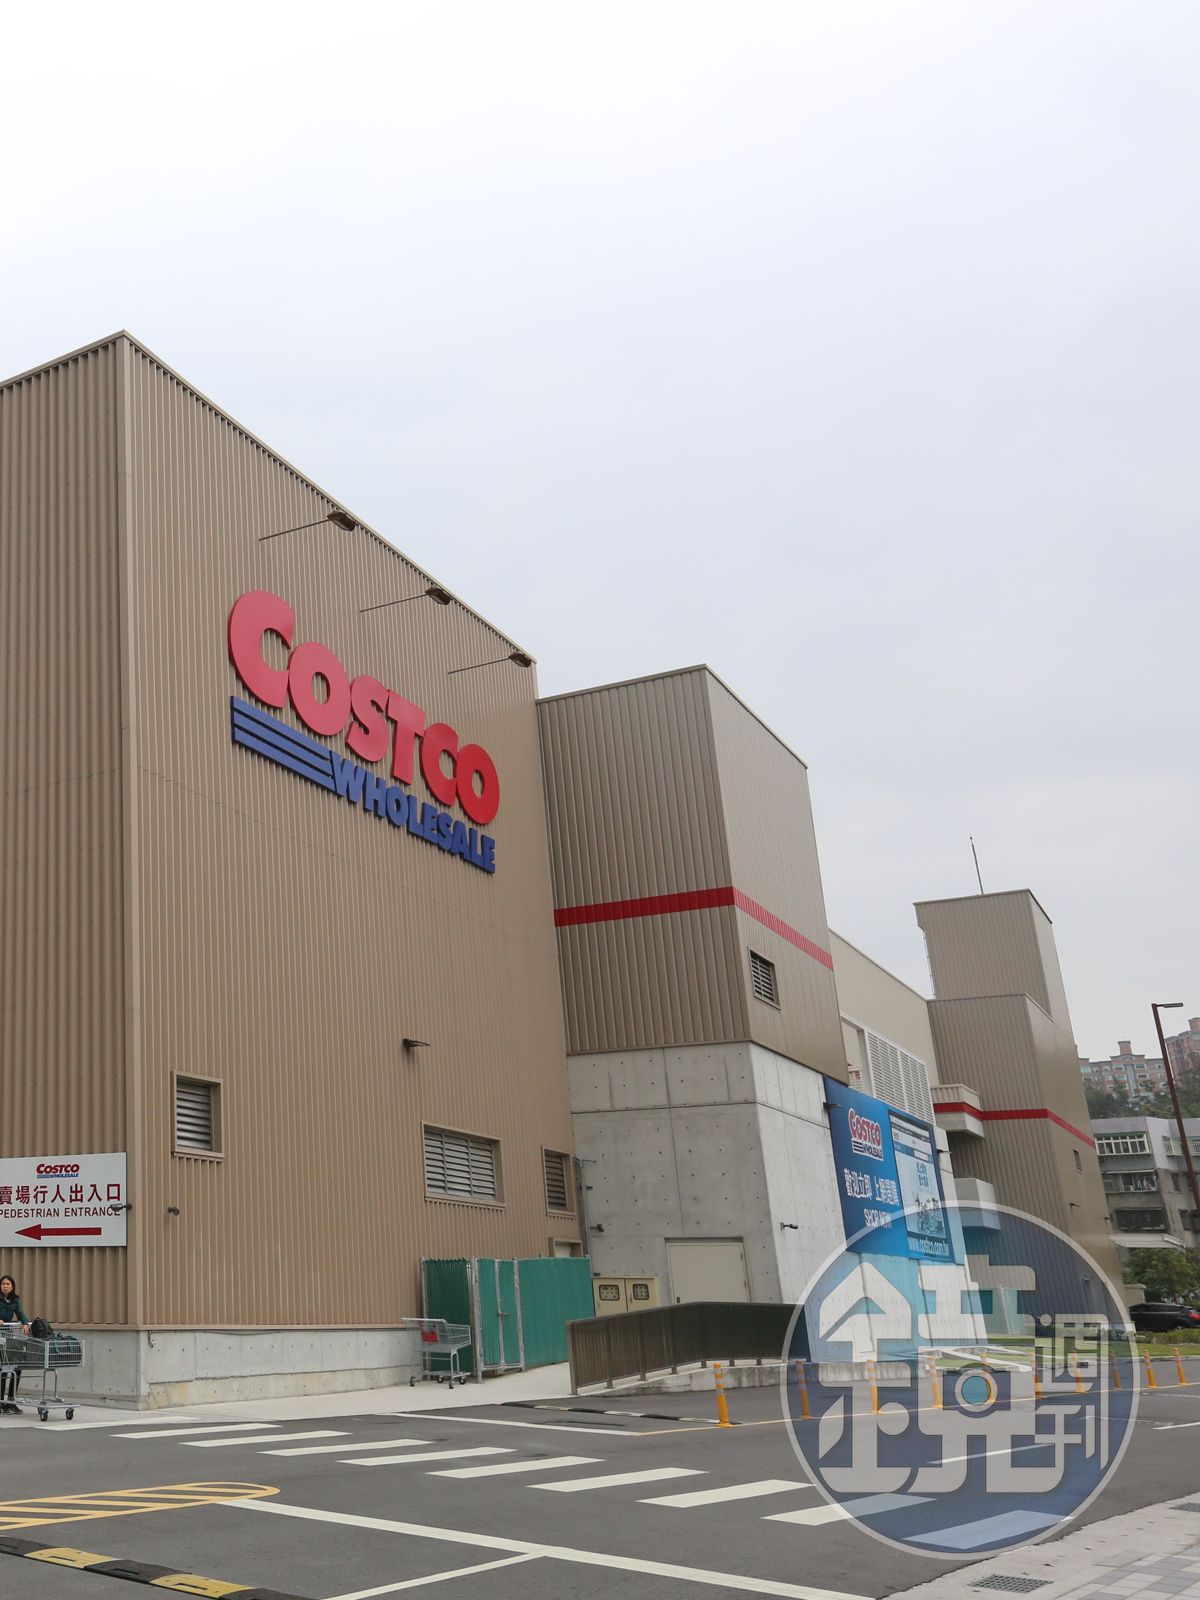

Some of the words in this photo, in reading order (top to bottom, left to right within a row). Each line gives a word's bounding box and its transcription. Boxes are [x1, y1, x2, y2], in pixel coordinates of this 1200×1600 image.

[228, 590, 500, 825] COSTCO
[329, 750, 496, 873] WHOLESALE
[848, 1107, 882, 1147] COSTCO
[36, 1163, 80, 1174] COSTCO
